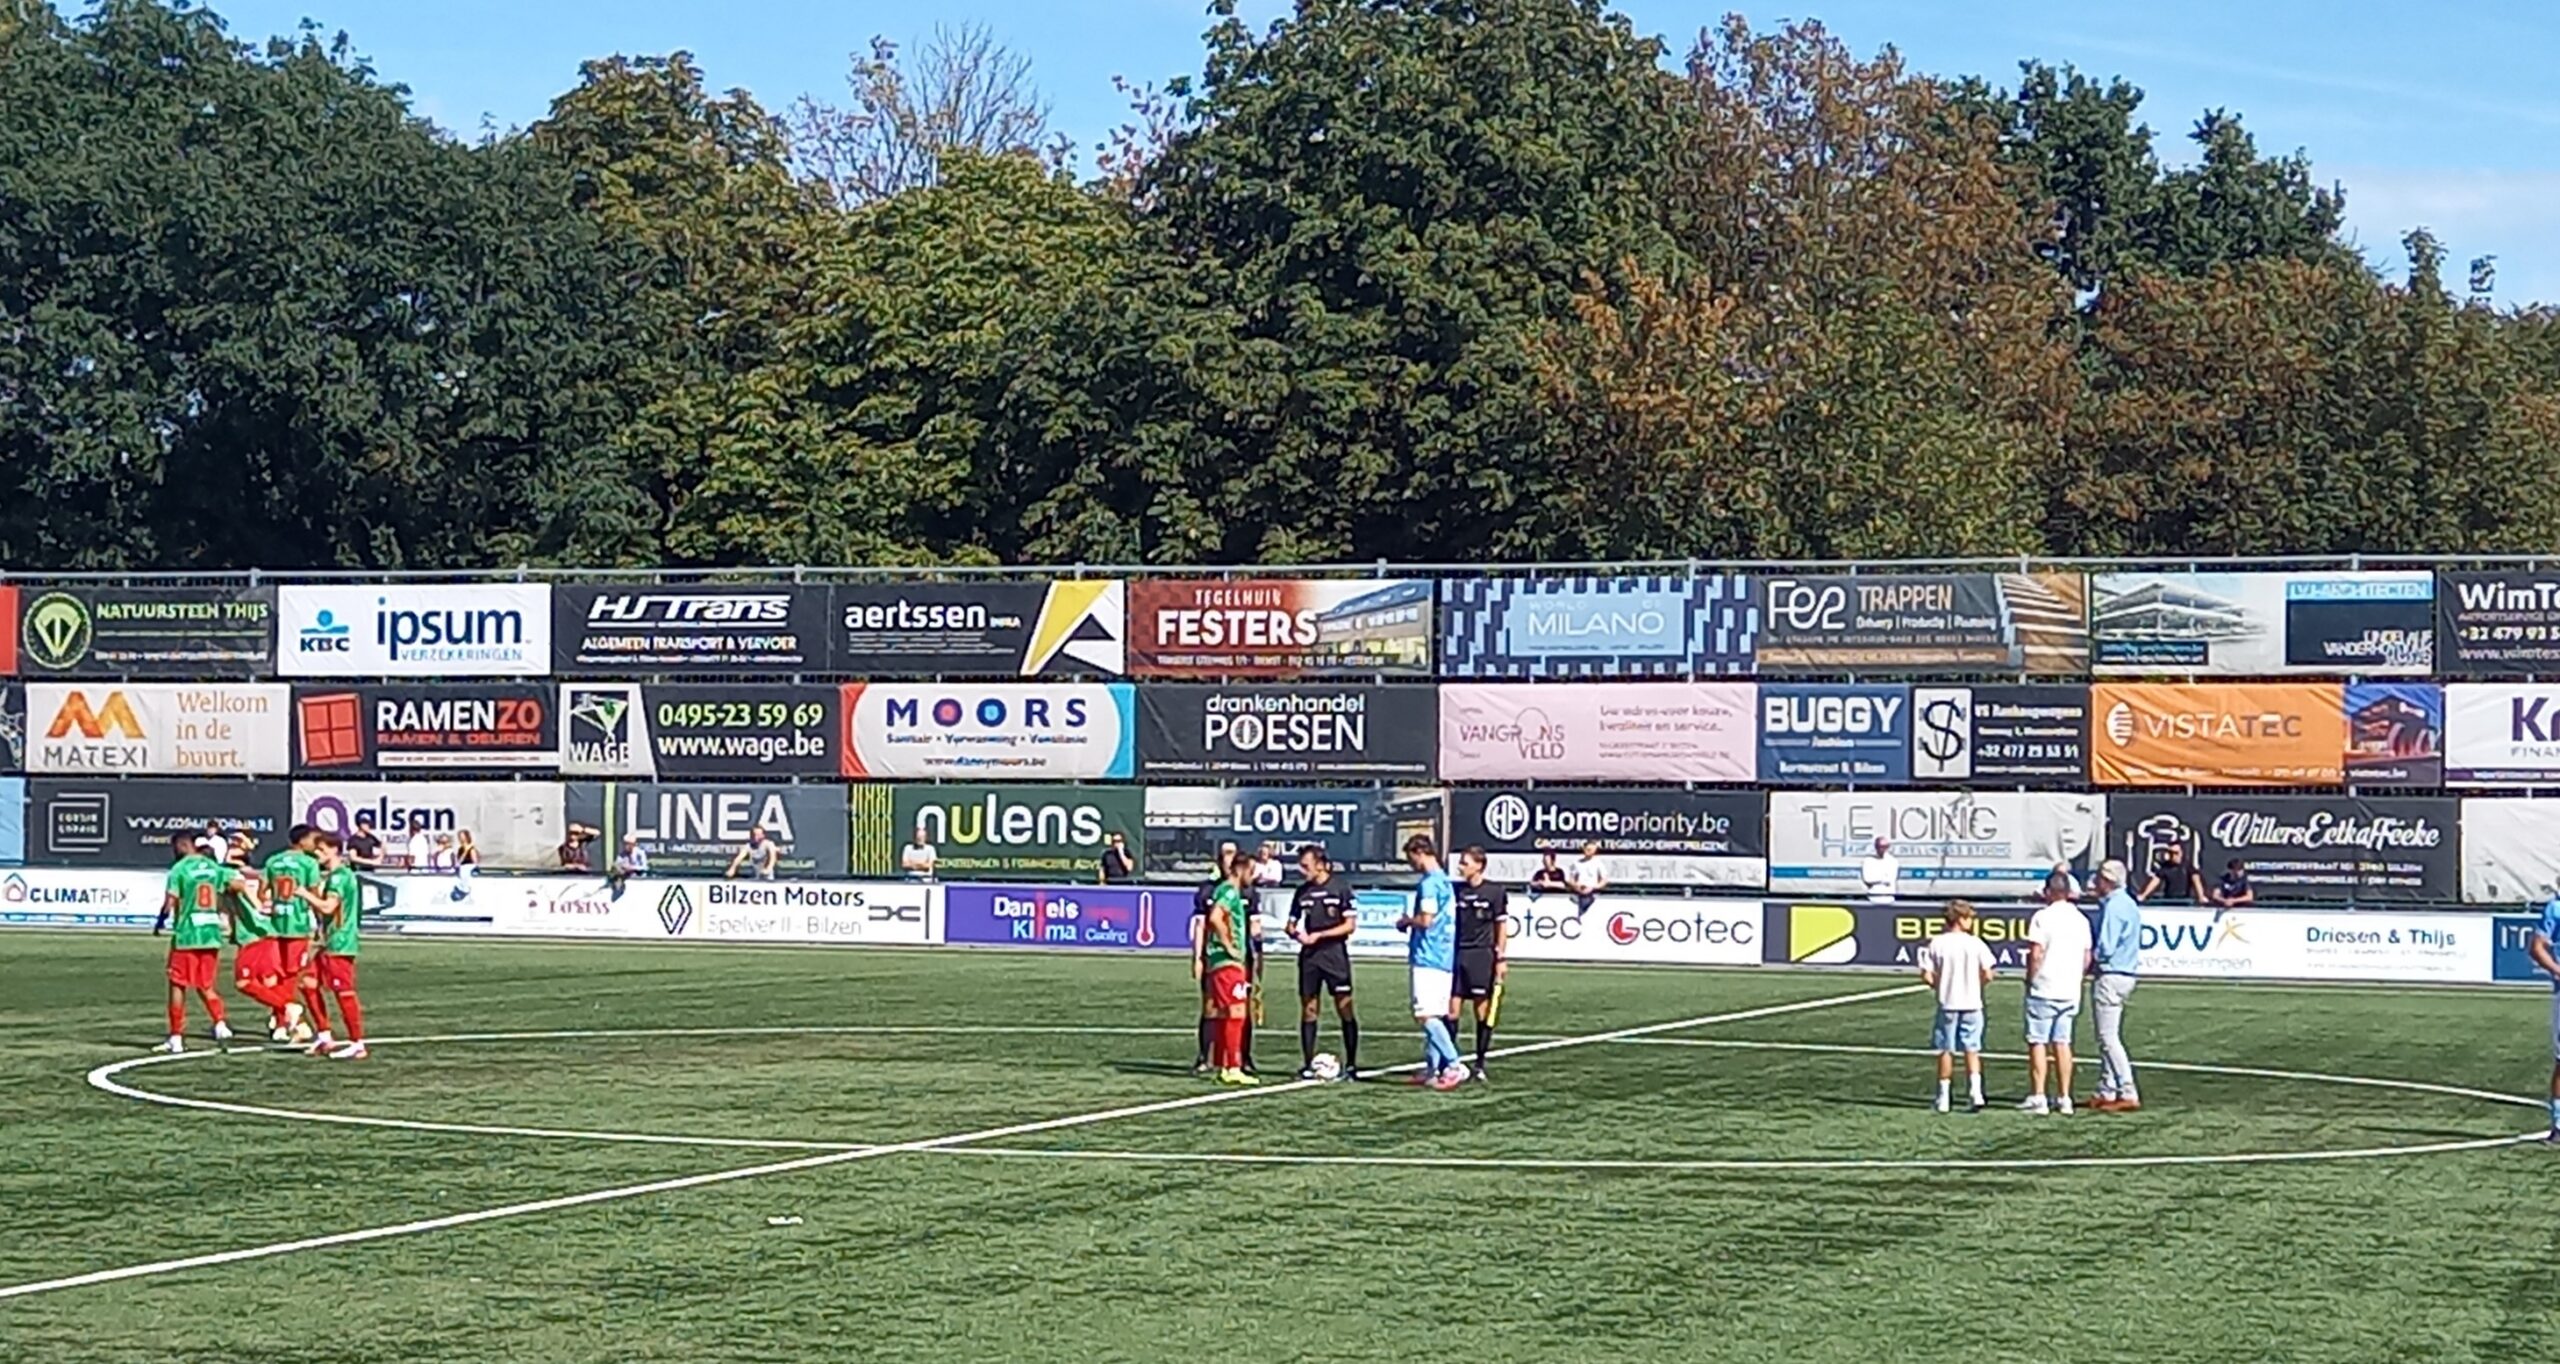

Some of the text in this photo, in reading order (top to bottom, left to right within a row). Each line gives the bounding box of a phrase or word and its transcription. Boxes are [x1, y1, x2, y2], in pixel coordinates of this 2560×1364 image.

[1856, 585, 1953, 611] TRAPPEN
[97, 603, 269, 621] NATUURSTEEN THIJS
[845, 599, 986, 628] aertssen
[1529, 612, 1665, 636] MILANO
[377, 596, 523, 661] ipsum
[1158, 611, 1318, 646] FESTERS
[2492, 626, 2523, 641] 479
[300, 637, 350, 652] KBC
[401, 649, 523, 661] VERZEKERINGEN
[653, 636, 724, 650] TRANSPORT
[738, 636, 797, 650] VERVOER
[176, 692, 268, 713] Welkom
[886, 698, 1086, 727] MOORS
[1206, 694, 1365, 712] drankenhandel
[377, 701, 541, 731] RAMENZO
[658, 704, 823, 727] 0495-23 59 69
[1766, 697, 1901, 733] BUGGY
[2146, 713, 2301, 738] VISTATEC
[176, 719, 231, 740] in de
[377, 734, 443, 745] RAMEN
[466, 734, 541, 745] DEUREN
[1205, 714, 1364, 750] POESEN
[44, 746, 147, 767] MATEXI
[176, 746, 245, 767] buurt.
[571, 741, 629, 763] WAGE
[657, 730, 824, 763] www.wage.be
[355, 796, 455, 831] alsan
[626, 793, 793, 841] LINEA
[1234, 804, 1357, 833] LOWET
[1890, 806, 1998, 840] ICING
[30, 888, 128, 903] CLIMATRIX
[196, 884, 212, 909] 8
[709, 885, 864, 906] Bilzen Motors
[807, 916, 862, 934] Bilzen
[1507, 909, 1582, 939] otec
[1607, 911, 1754, 945] Geotec
[2306, 927, 2456, 948] Driesen & Thijs
